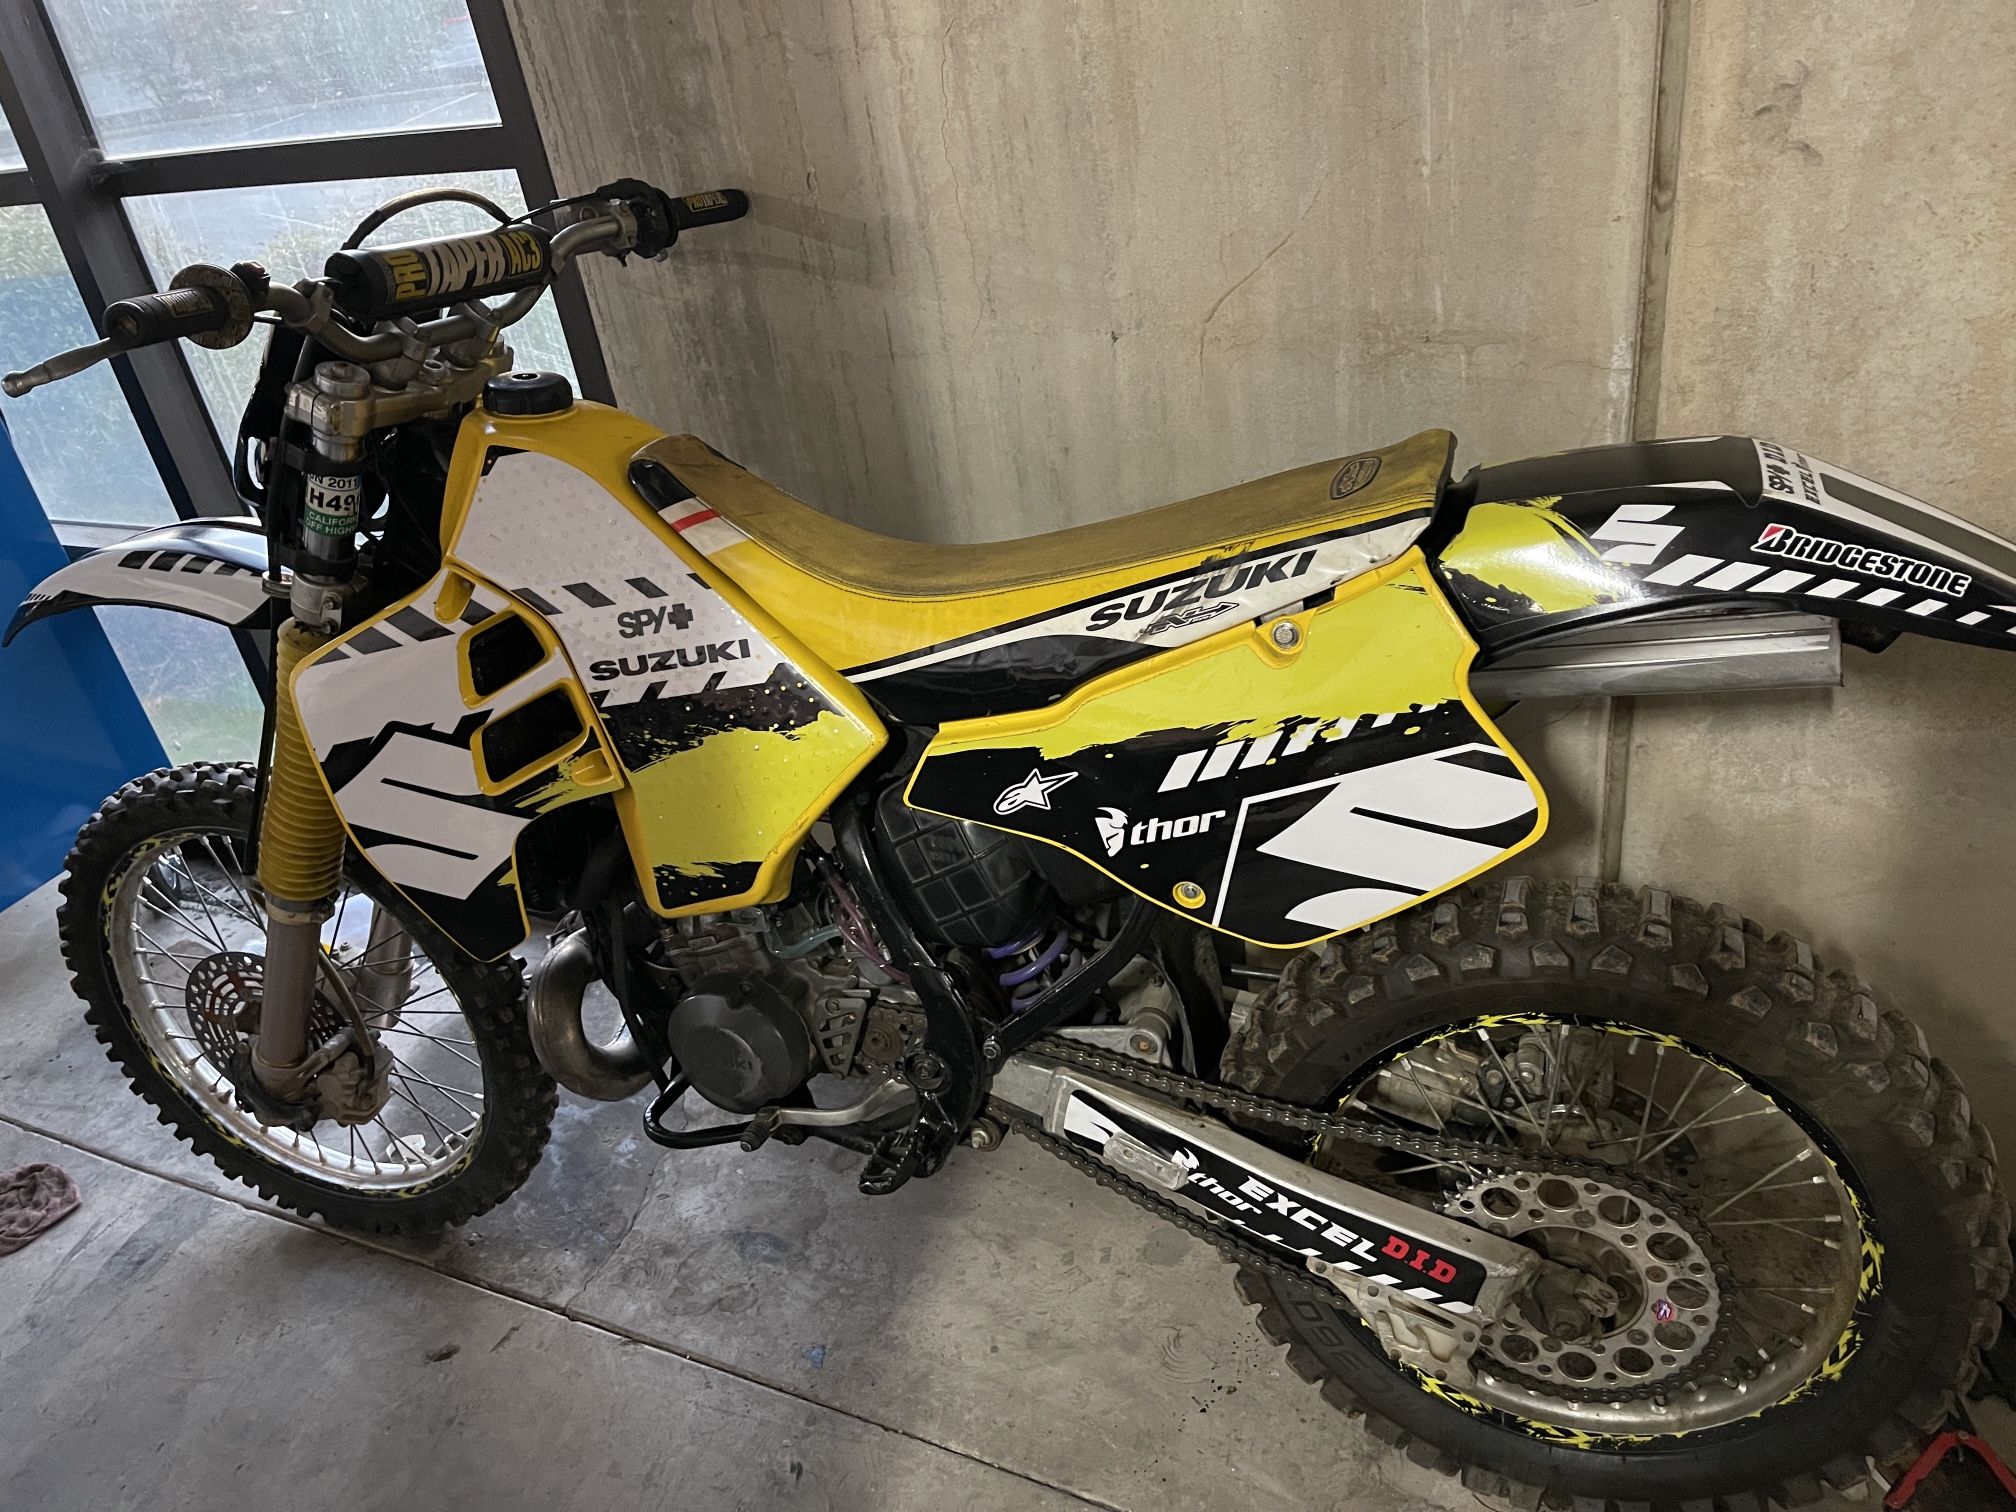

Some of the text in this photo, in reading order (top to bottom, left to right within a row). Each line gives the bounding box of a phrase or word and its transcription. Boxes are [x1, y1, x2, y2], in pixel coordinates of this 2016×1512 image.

[415, 236, 506, 296] TAPER
[501, 231, 542, 275] AC3
[328, 478, 357, 489] 2011
[1751, 523, 1972, 597] BRIDGESTONE
[1086, 550, 1319, 631] SUZUKI
[590, 639, 751, 681] SUZUKI
[1130, 810, 1226, 845] thor
[1188, 1170, 1262, 1214] thor
[1238, 1175, 1379, 1263] EXCEL
